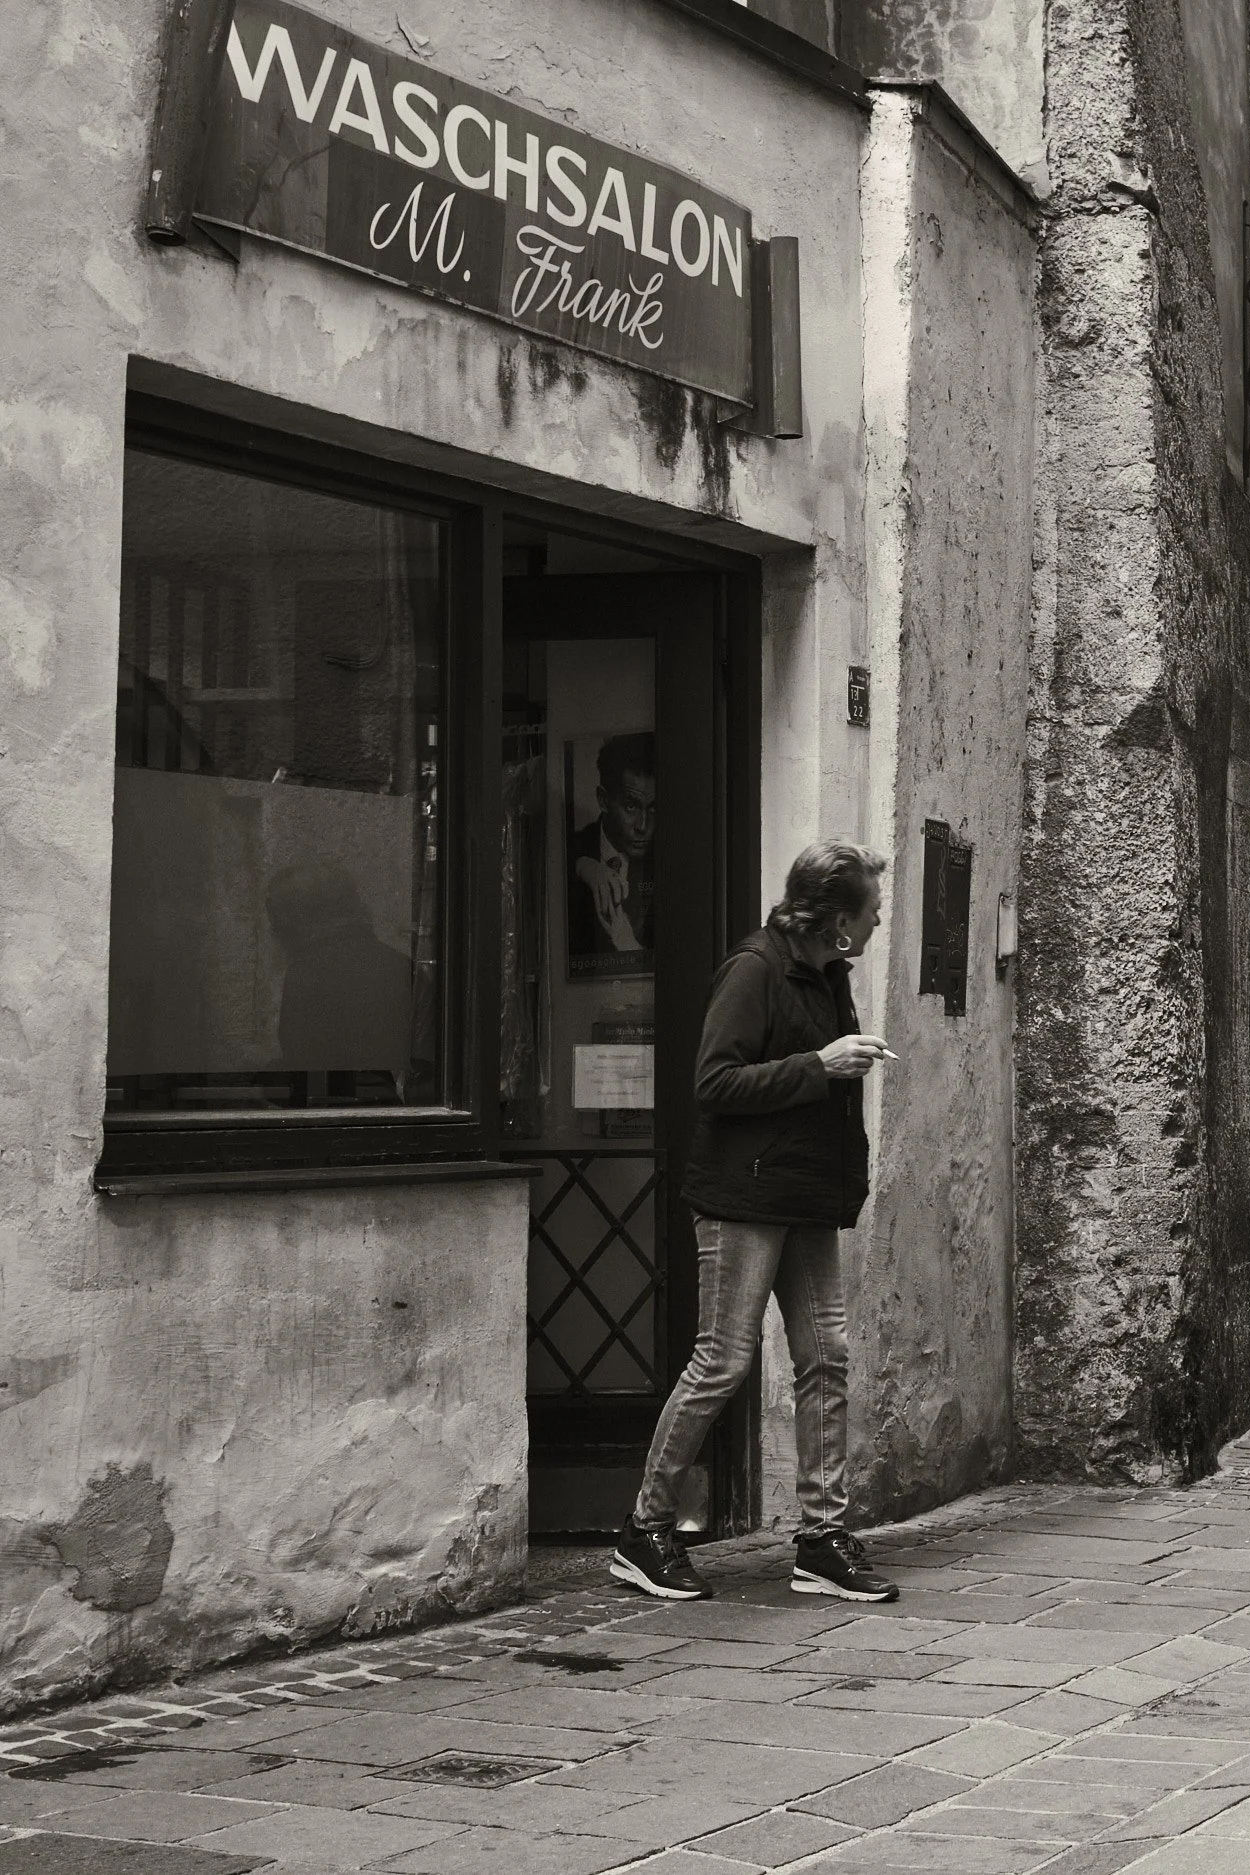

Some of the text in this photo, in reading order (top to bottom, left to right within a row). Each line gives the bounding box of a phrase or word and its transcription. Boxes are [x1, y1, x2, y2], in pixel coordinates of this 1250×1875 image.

[226, 19, 743, 298] WASCHSALON
[369, 182, 664, 349] M. Frank
[853, 705, 863, 718] 22
